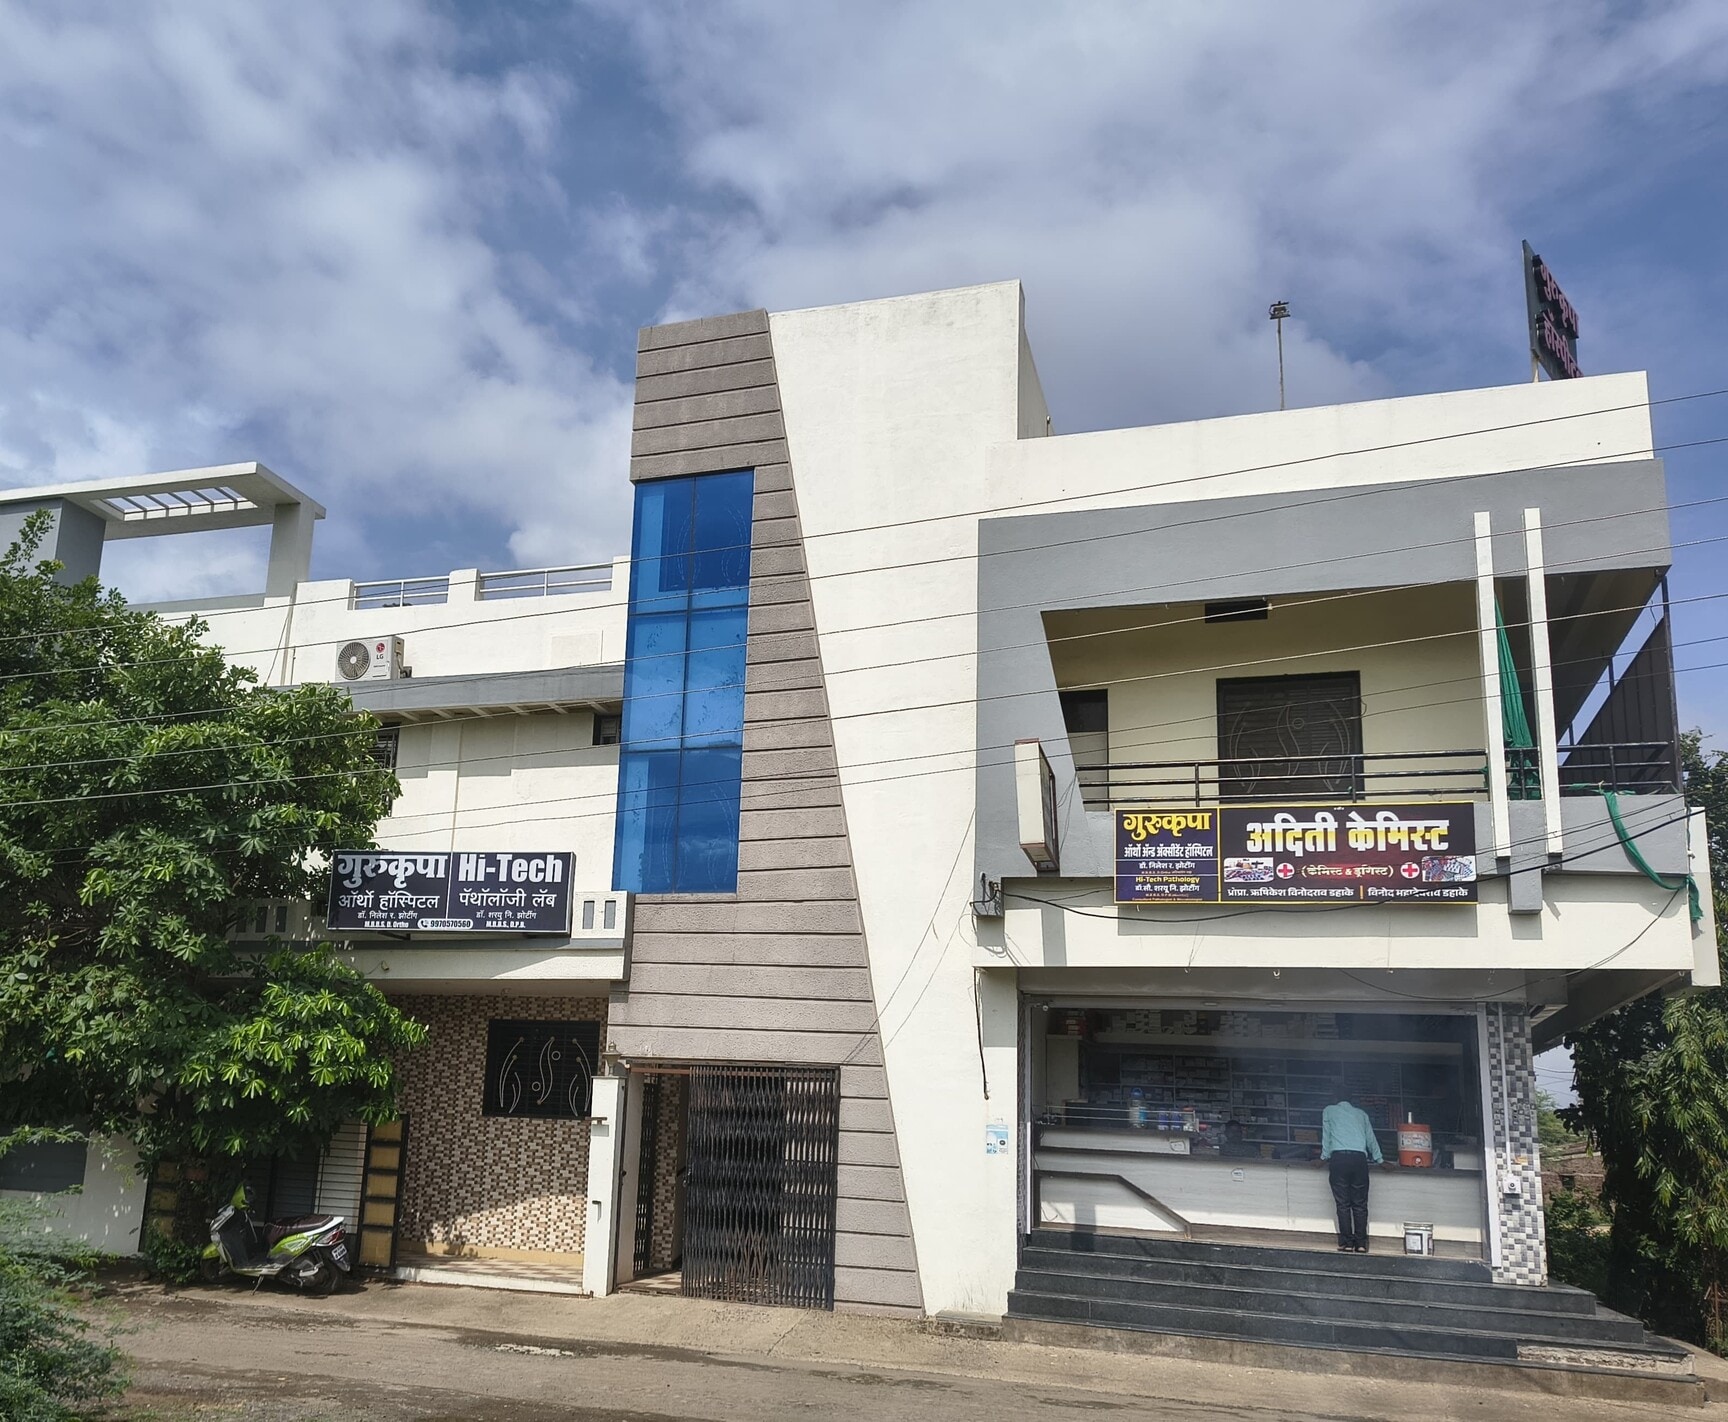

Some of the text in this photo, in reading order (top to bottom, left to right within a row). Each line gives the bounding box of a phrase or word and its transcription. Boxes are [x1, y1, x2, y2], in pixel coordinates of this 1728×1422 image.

[1122, 813, 1212, 841] गुरुकृपा
[1246, 811, 1450, 857] अदिती केमिस्ट
[1184, 843, 1214, 859] हॉस्पिटल
[337, 854, 448, 889] गुरुकृपा
[458, 853, 563, 883] Hi-Tech
[1344, 868, 1353, 876] &
[1163, 876, 1200, 884] Pathology
[459, 887, 557, 908] पॅथॉलॉजी लॅब
[1287, 886, 1328, 897] विनोदराव
[1328, 886, 1355, 898] डहाके
[1367, 886, 1395, 898] विनोद
[1441, 886, 1469, 898] डहाके
[338, 890, 440, 911] ऑर्थो हॉस्पिटल
[357, 910, 367, 919] डॉ.
[369, 910, 388, 919] निलेश
[476, 909, 486, 919] डॉ.
